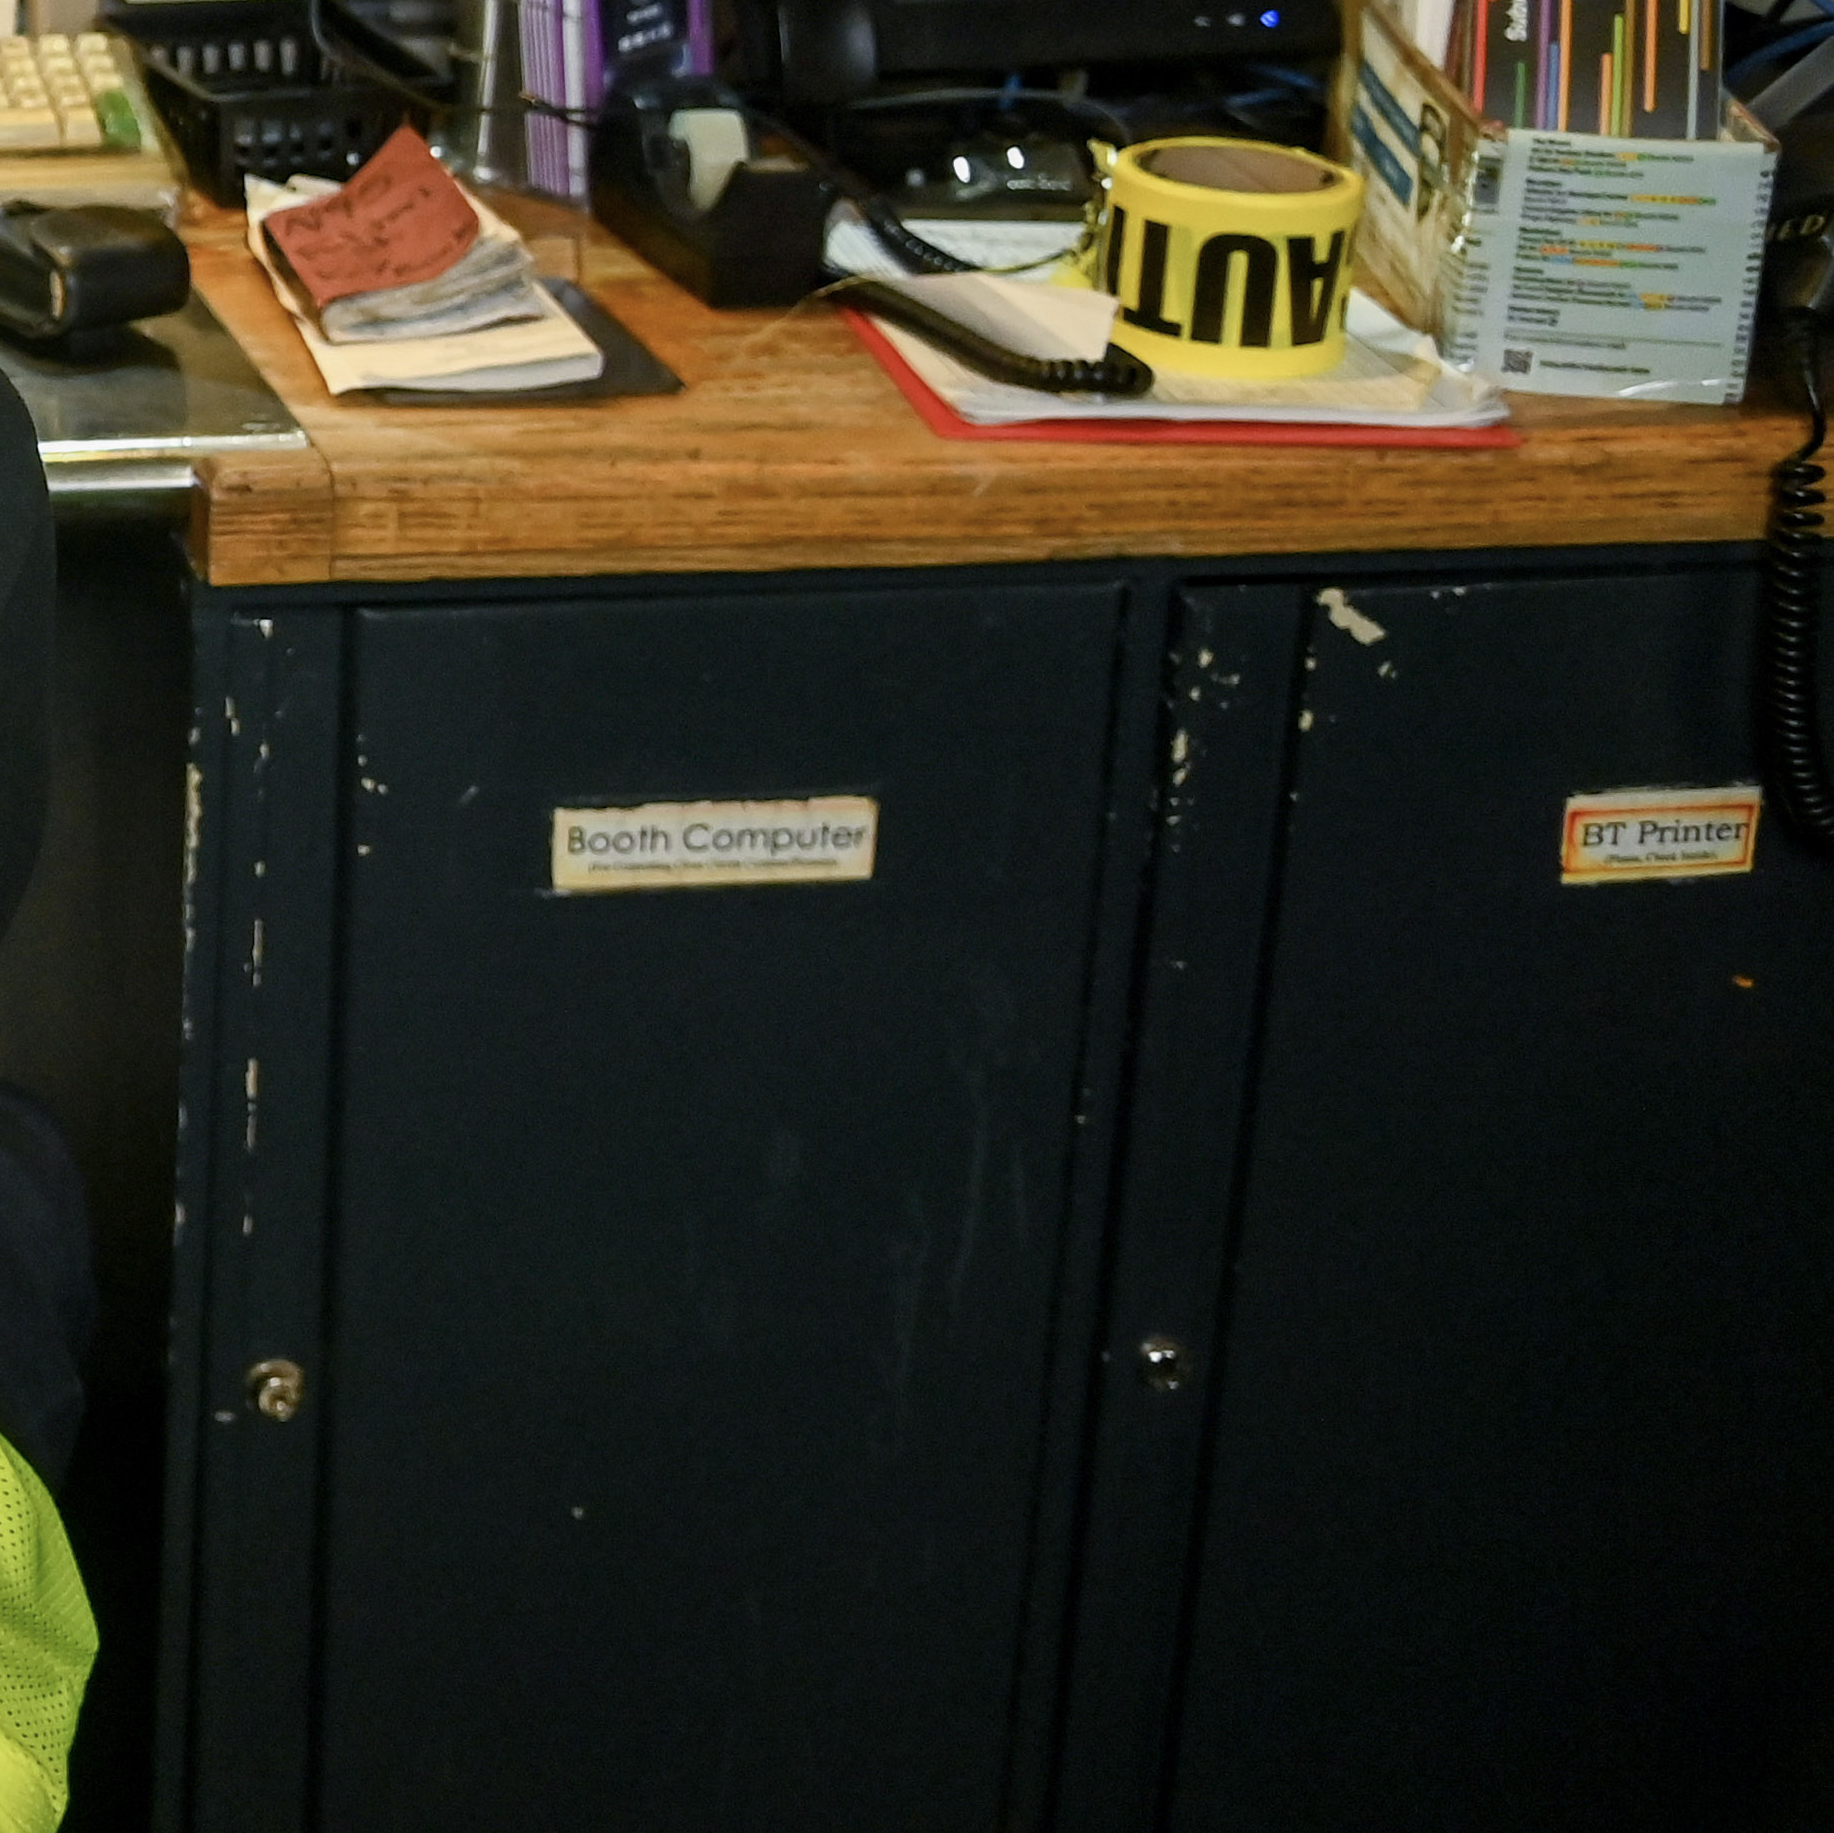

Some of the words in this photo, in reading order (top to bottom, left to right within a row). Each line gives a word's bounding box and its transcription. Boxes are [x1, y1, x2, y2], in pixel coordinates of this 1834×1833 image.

[1105, 205, 1347, 349] AUTI
[567, 825, 671, 855] Booth
[682, 821, 867, 858] Computer
[1582, 821, 1627, 847] BT
[1638, 818, 1750, 845] Printer
